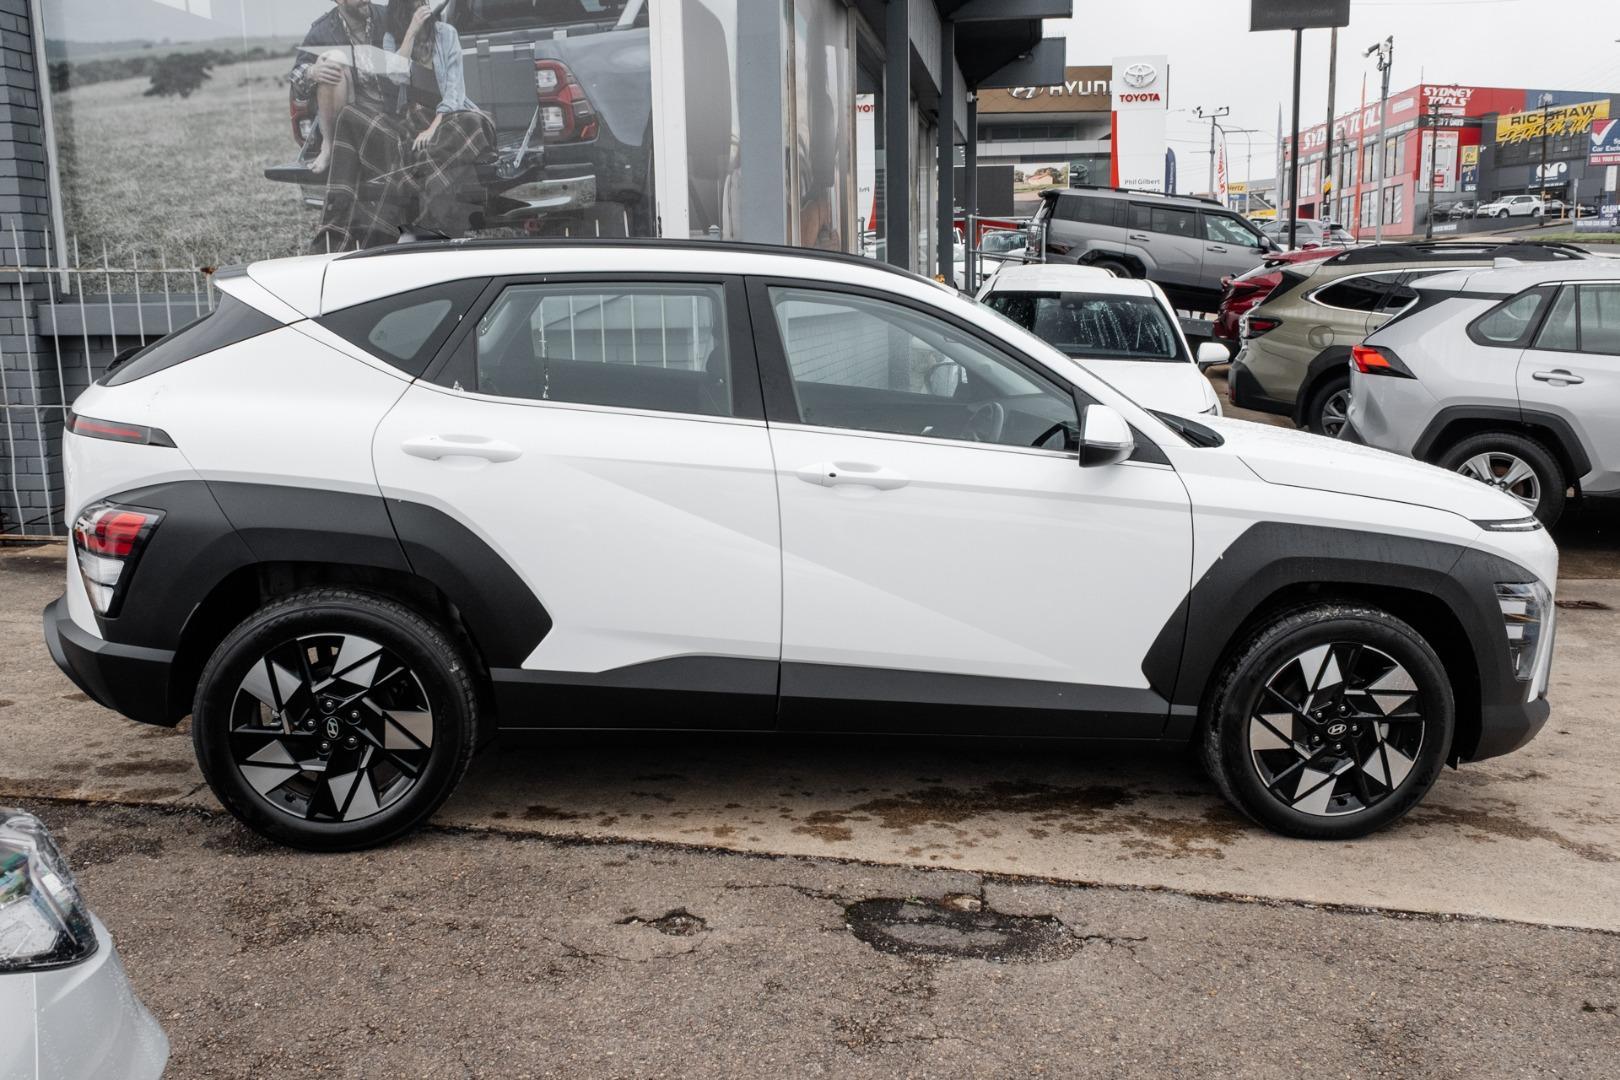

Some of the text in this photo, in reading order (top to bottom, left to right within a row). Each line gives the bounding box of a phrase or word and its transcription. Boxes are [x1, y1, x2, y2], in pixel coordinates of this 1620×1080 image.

[1049, 80, 1112, 96] HYUN
[1423, 87, 1474, 98] SYDNEY
[1119, 93, 1160, 102] TOYOTA
[1428, 96, 1470, 107] TOOLS
[1303, 121, 1348, 150] SYDEY
